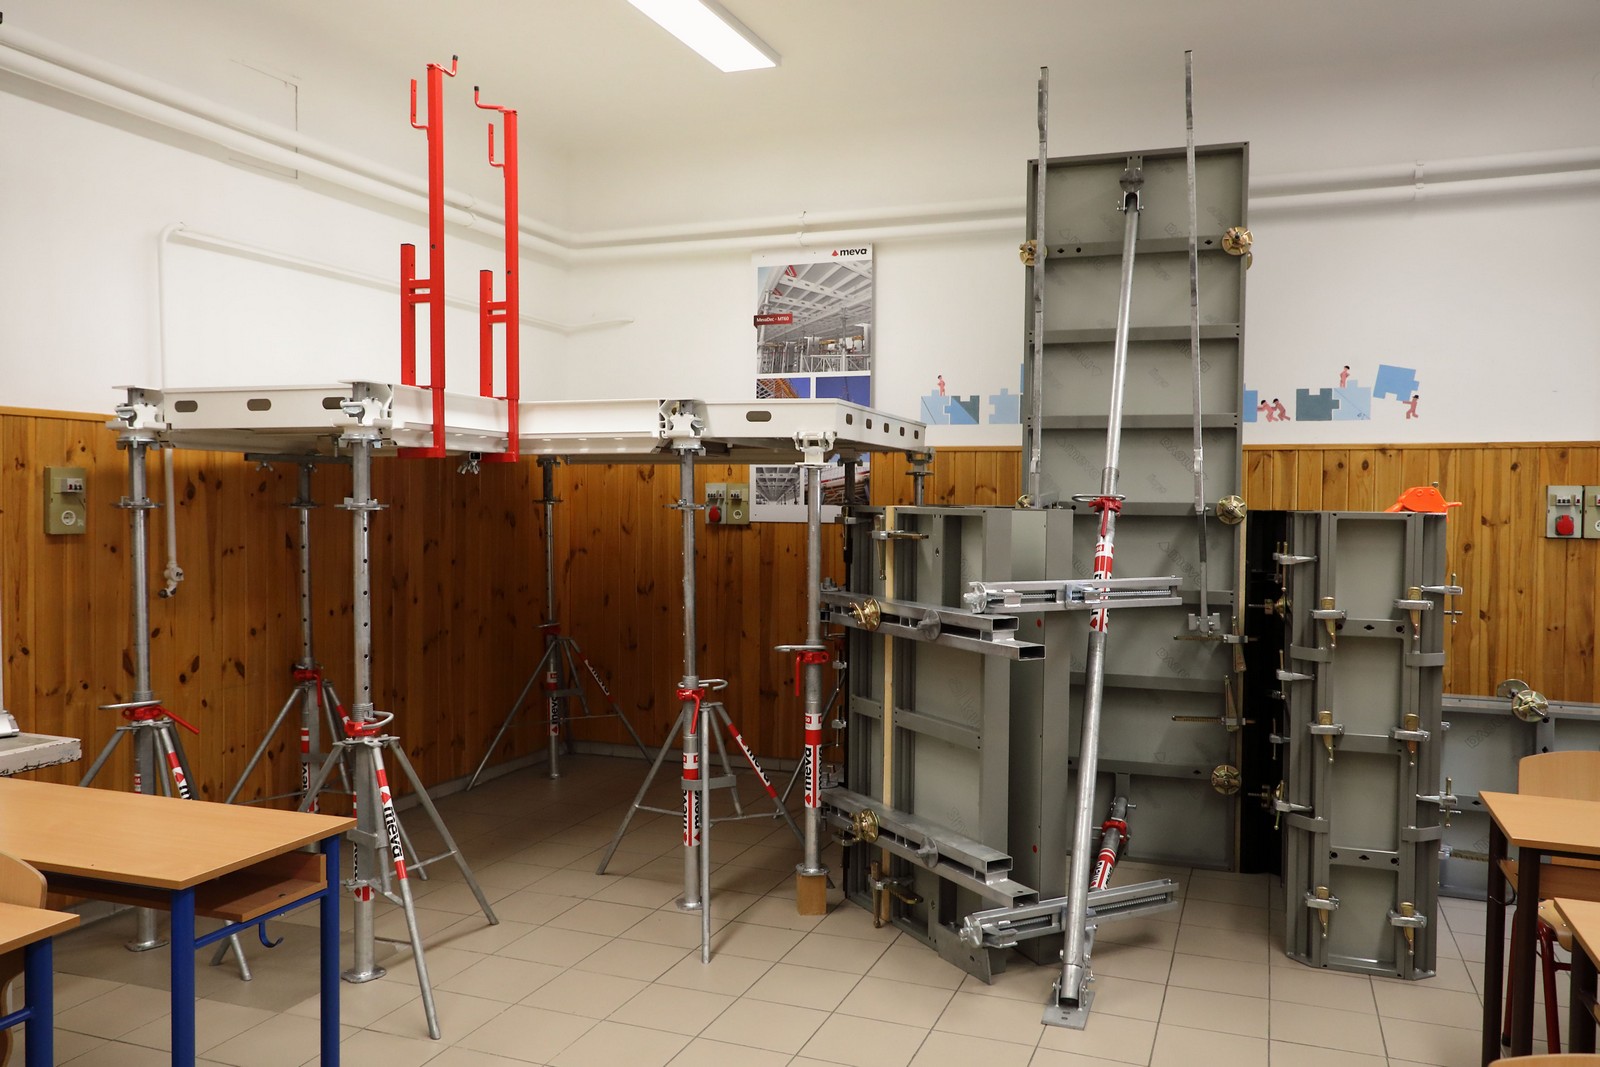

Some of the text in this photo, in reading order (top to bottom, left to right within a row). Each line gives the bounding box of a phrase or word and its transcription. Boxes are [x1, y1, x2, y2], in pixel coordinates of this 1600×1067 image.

[839, 248, 867, 256] meva
[804, 747, 812, 791] meva
[384, 806, 403, 858] meva
